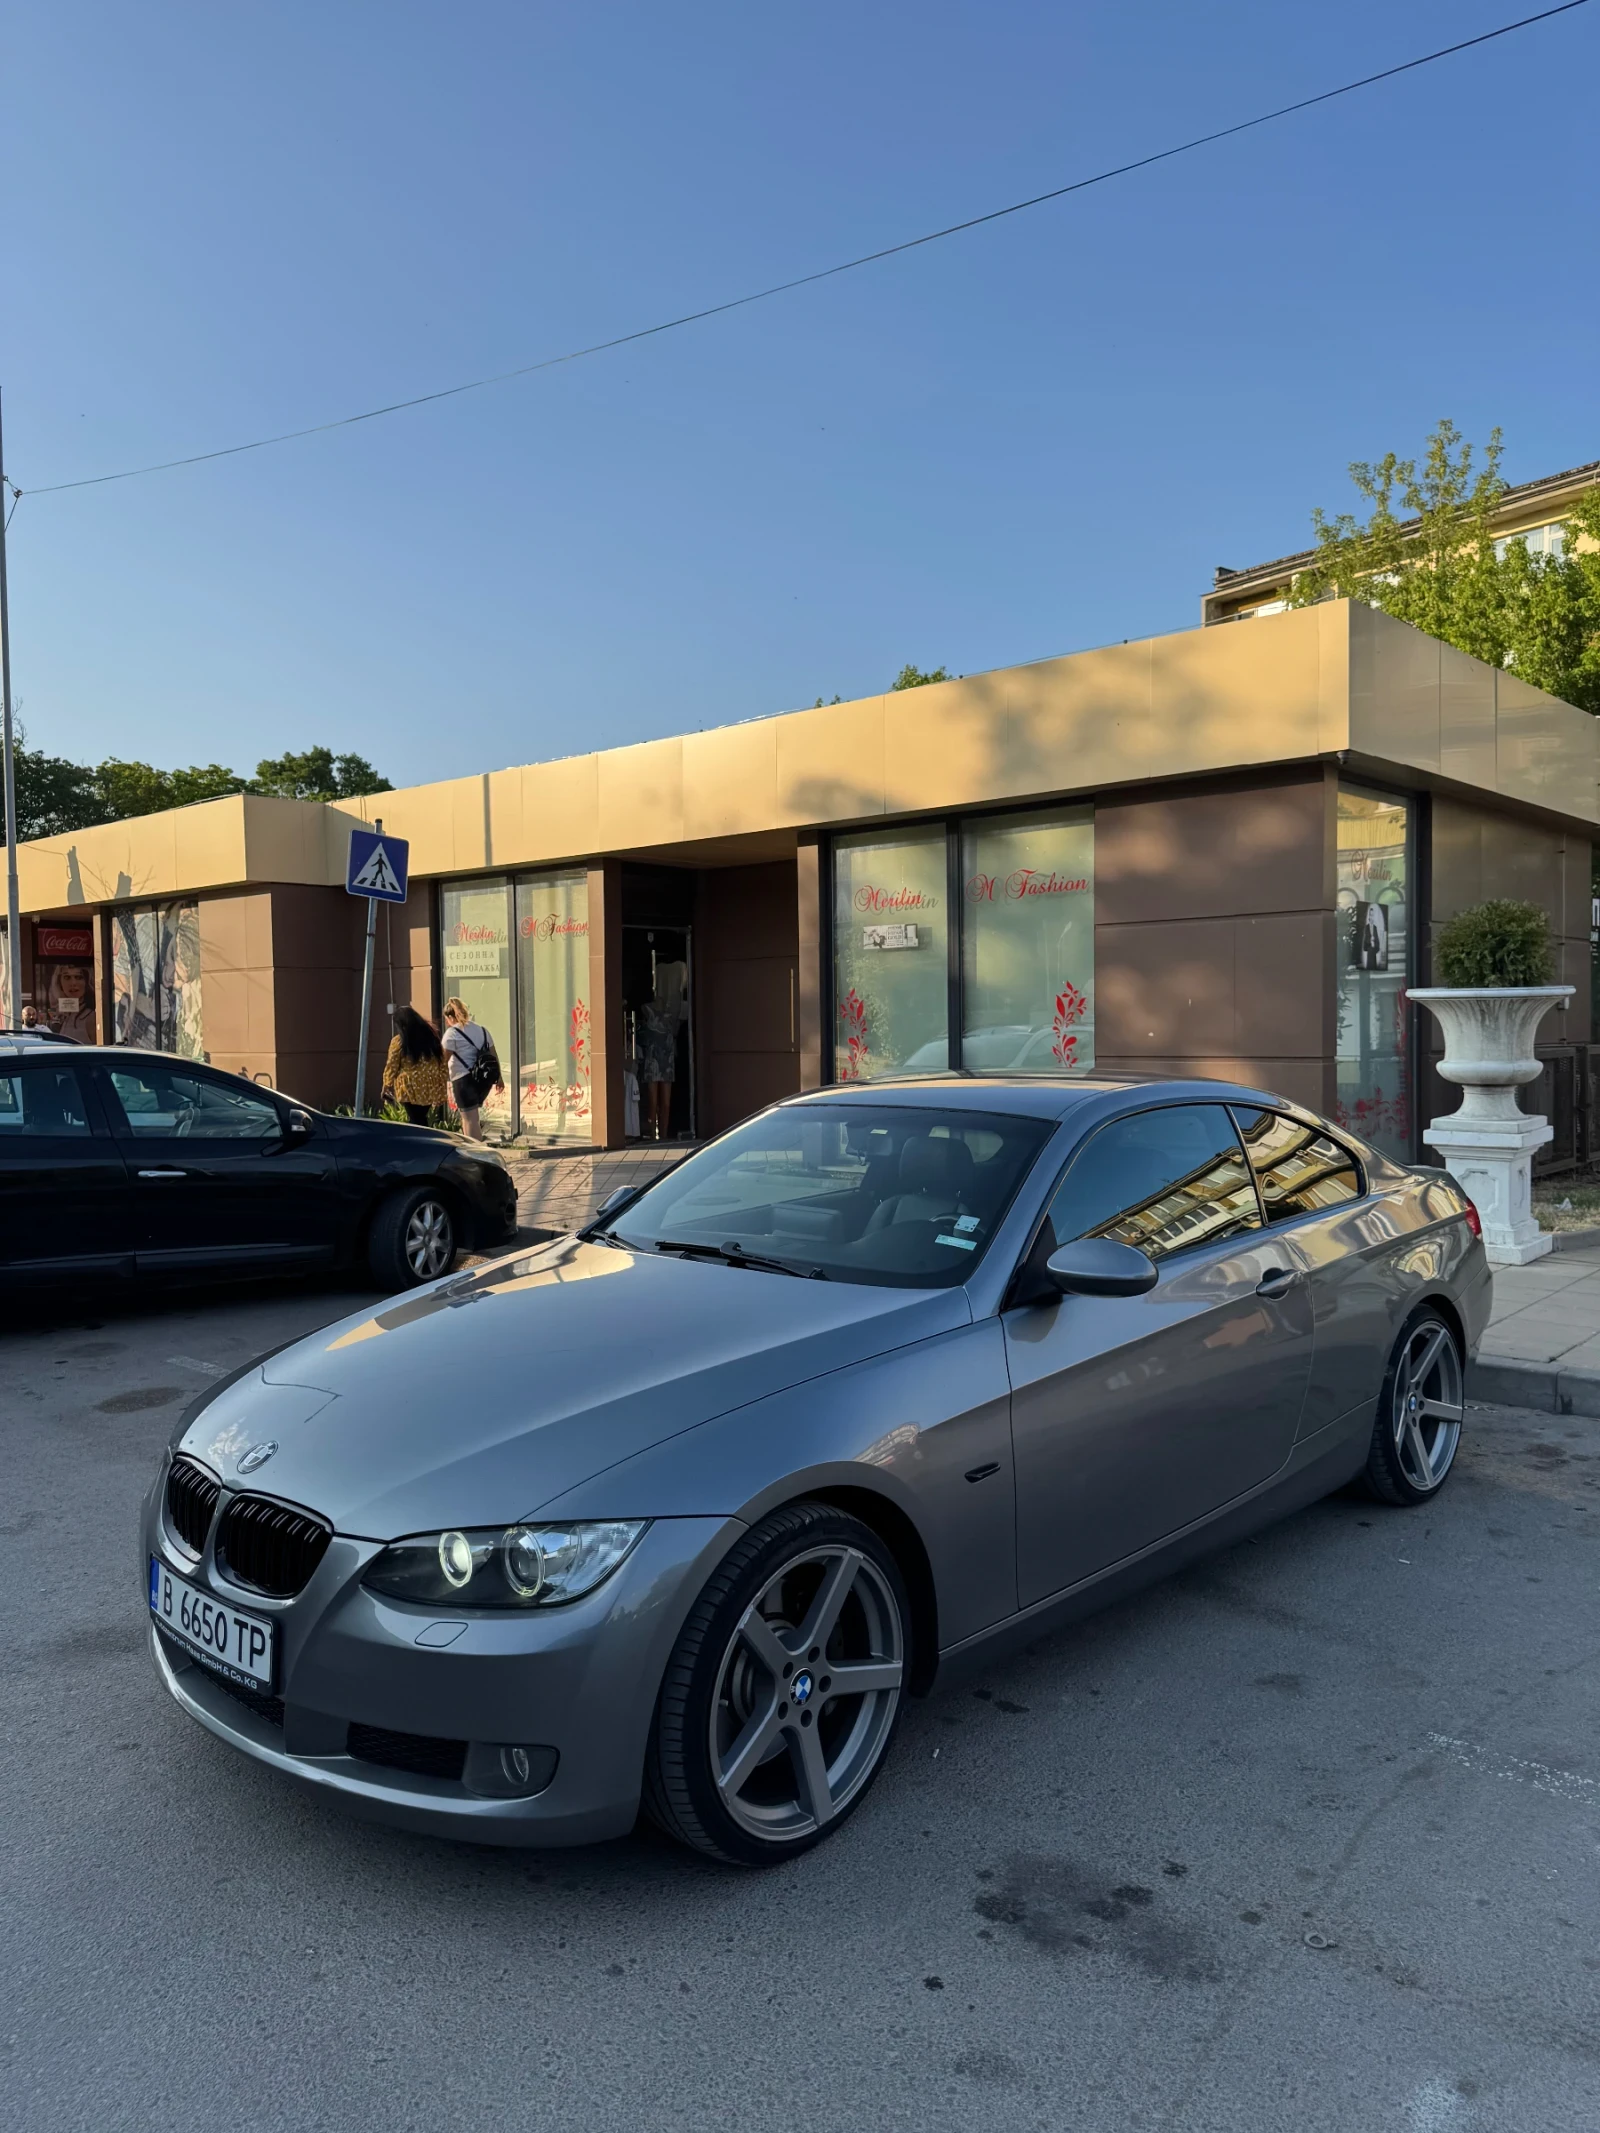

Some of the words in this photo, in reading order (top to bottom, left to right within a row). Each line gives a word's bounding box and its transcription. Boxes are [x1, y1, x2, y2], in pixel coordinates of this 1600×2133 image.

[1005, 869, 1089, 900] Fashion
[854, 885, 922, 912] Merilin
[453, 921, 495, 943] Merilin
[446, 963, 500, 973] РАЗПРОДАЖБА
[449, 950, 495, 960] СЕЗОННА
[163, 1574, 173, 1618] B
[180, 1590, 228, 1654] 6650
[233, 1617, 267, 1669] TP
[201, 1653, 222, 1673] GmbH
[222, 1665, 230, 1677] &
[230, 1669, 244, 1684] Co.
[244, 1676, 258, 1690] KG
